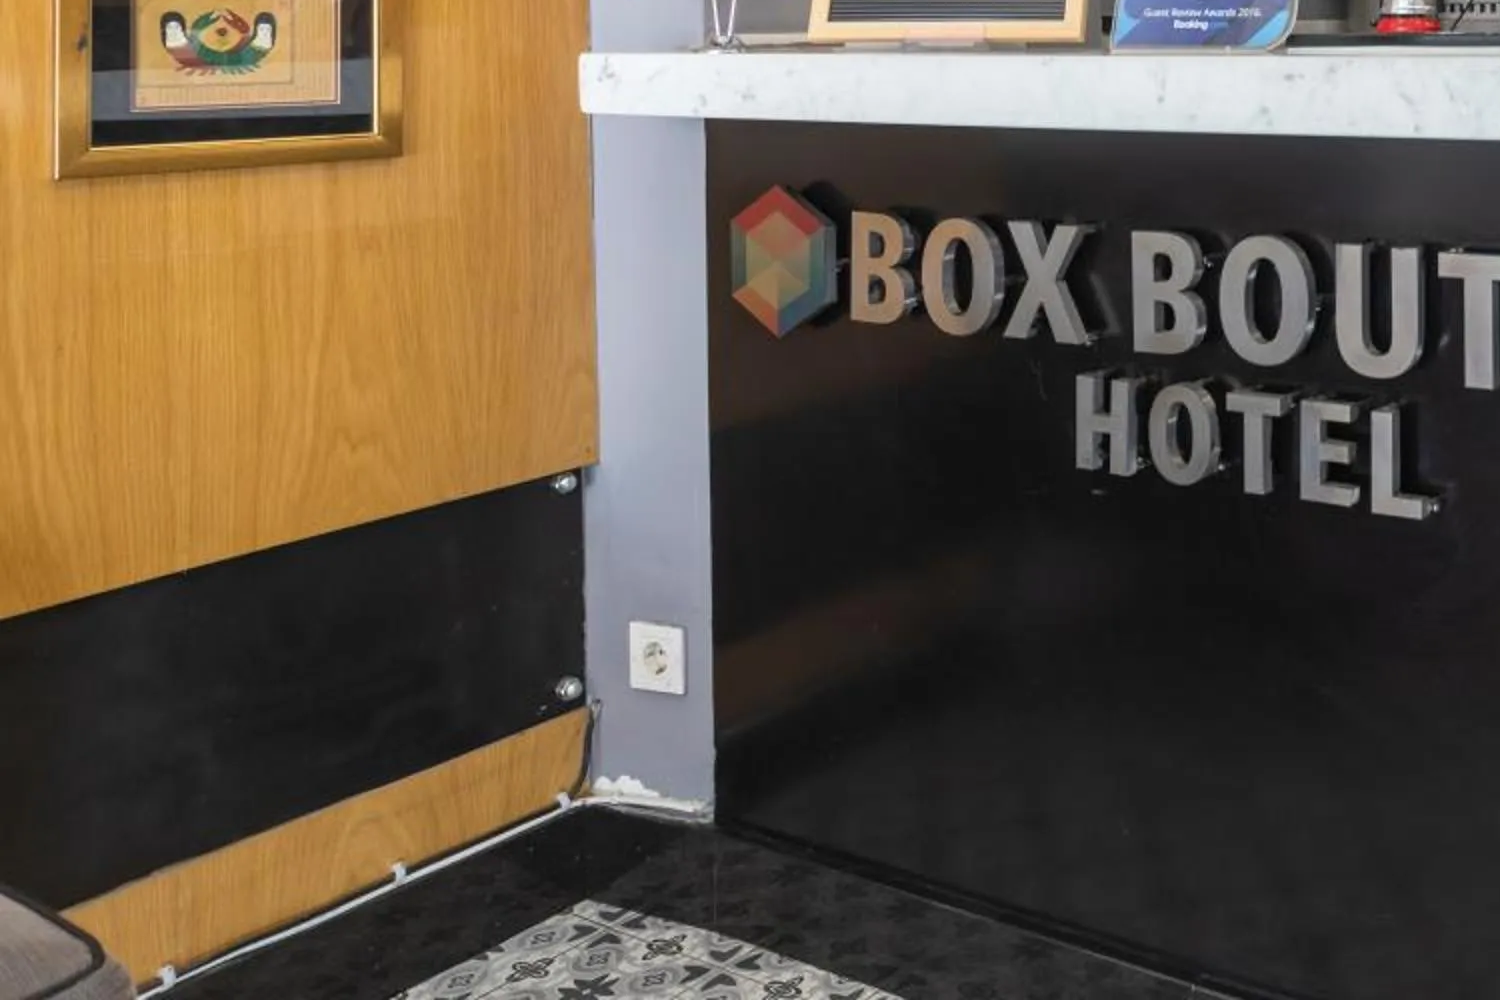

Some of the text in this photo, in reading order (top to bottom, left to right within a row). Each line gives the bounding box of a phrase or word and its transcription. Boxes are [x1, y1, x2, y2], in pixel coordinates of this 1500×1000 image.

[1143, 7, 1169, 17] Guest
[1171, 7, 1202, 18] Review
[1204, 7, 1237, 17] Awards
[850, 210, 1094, 346] BOX
[1074, 370, 1434, 522] HOTEL
